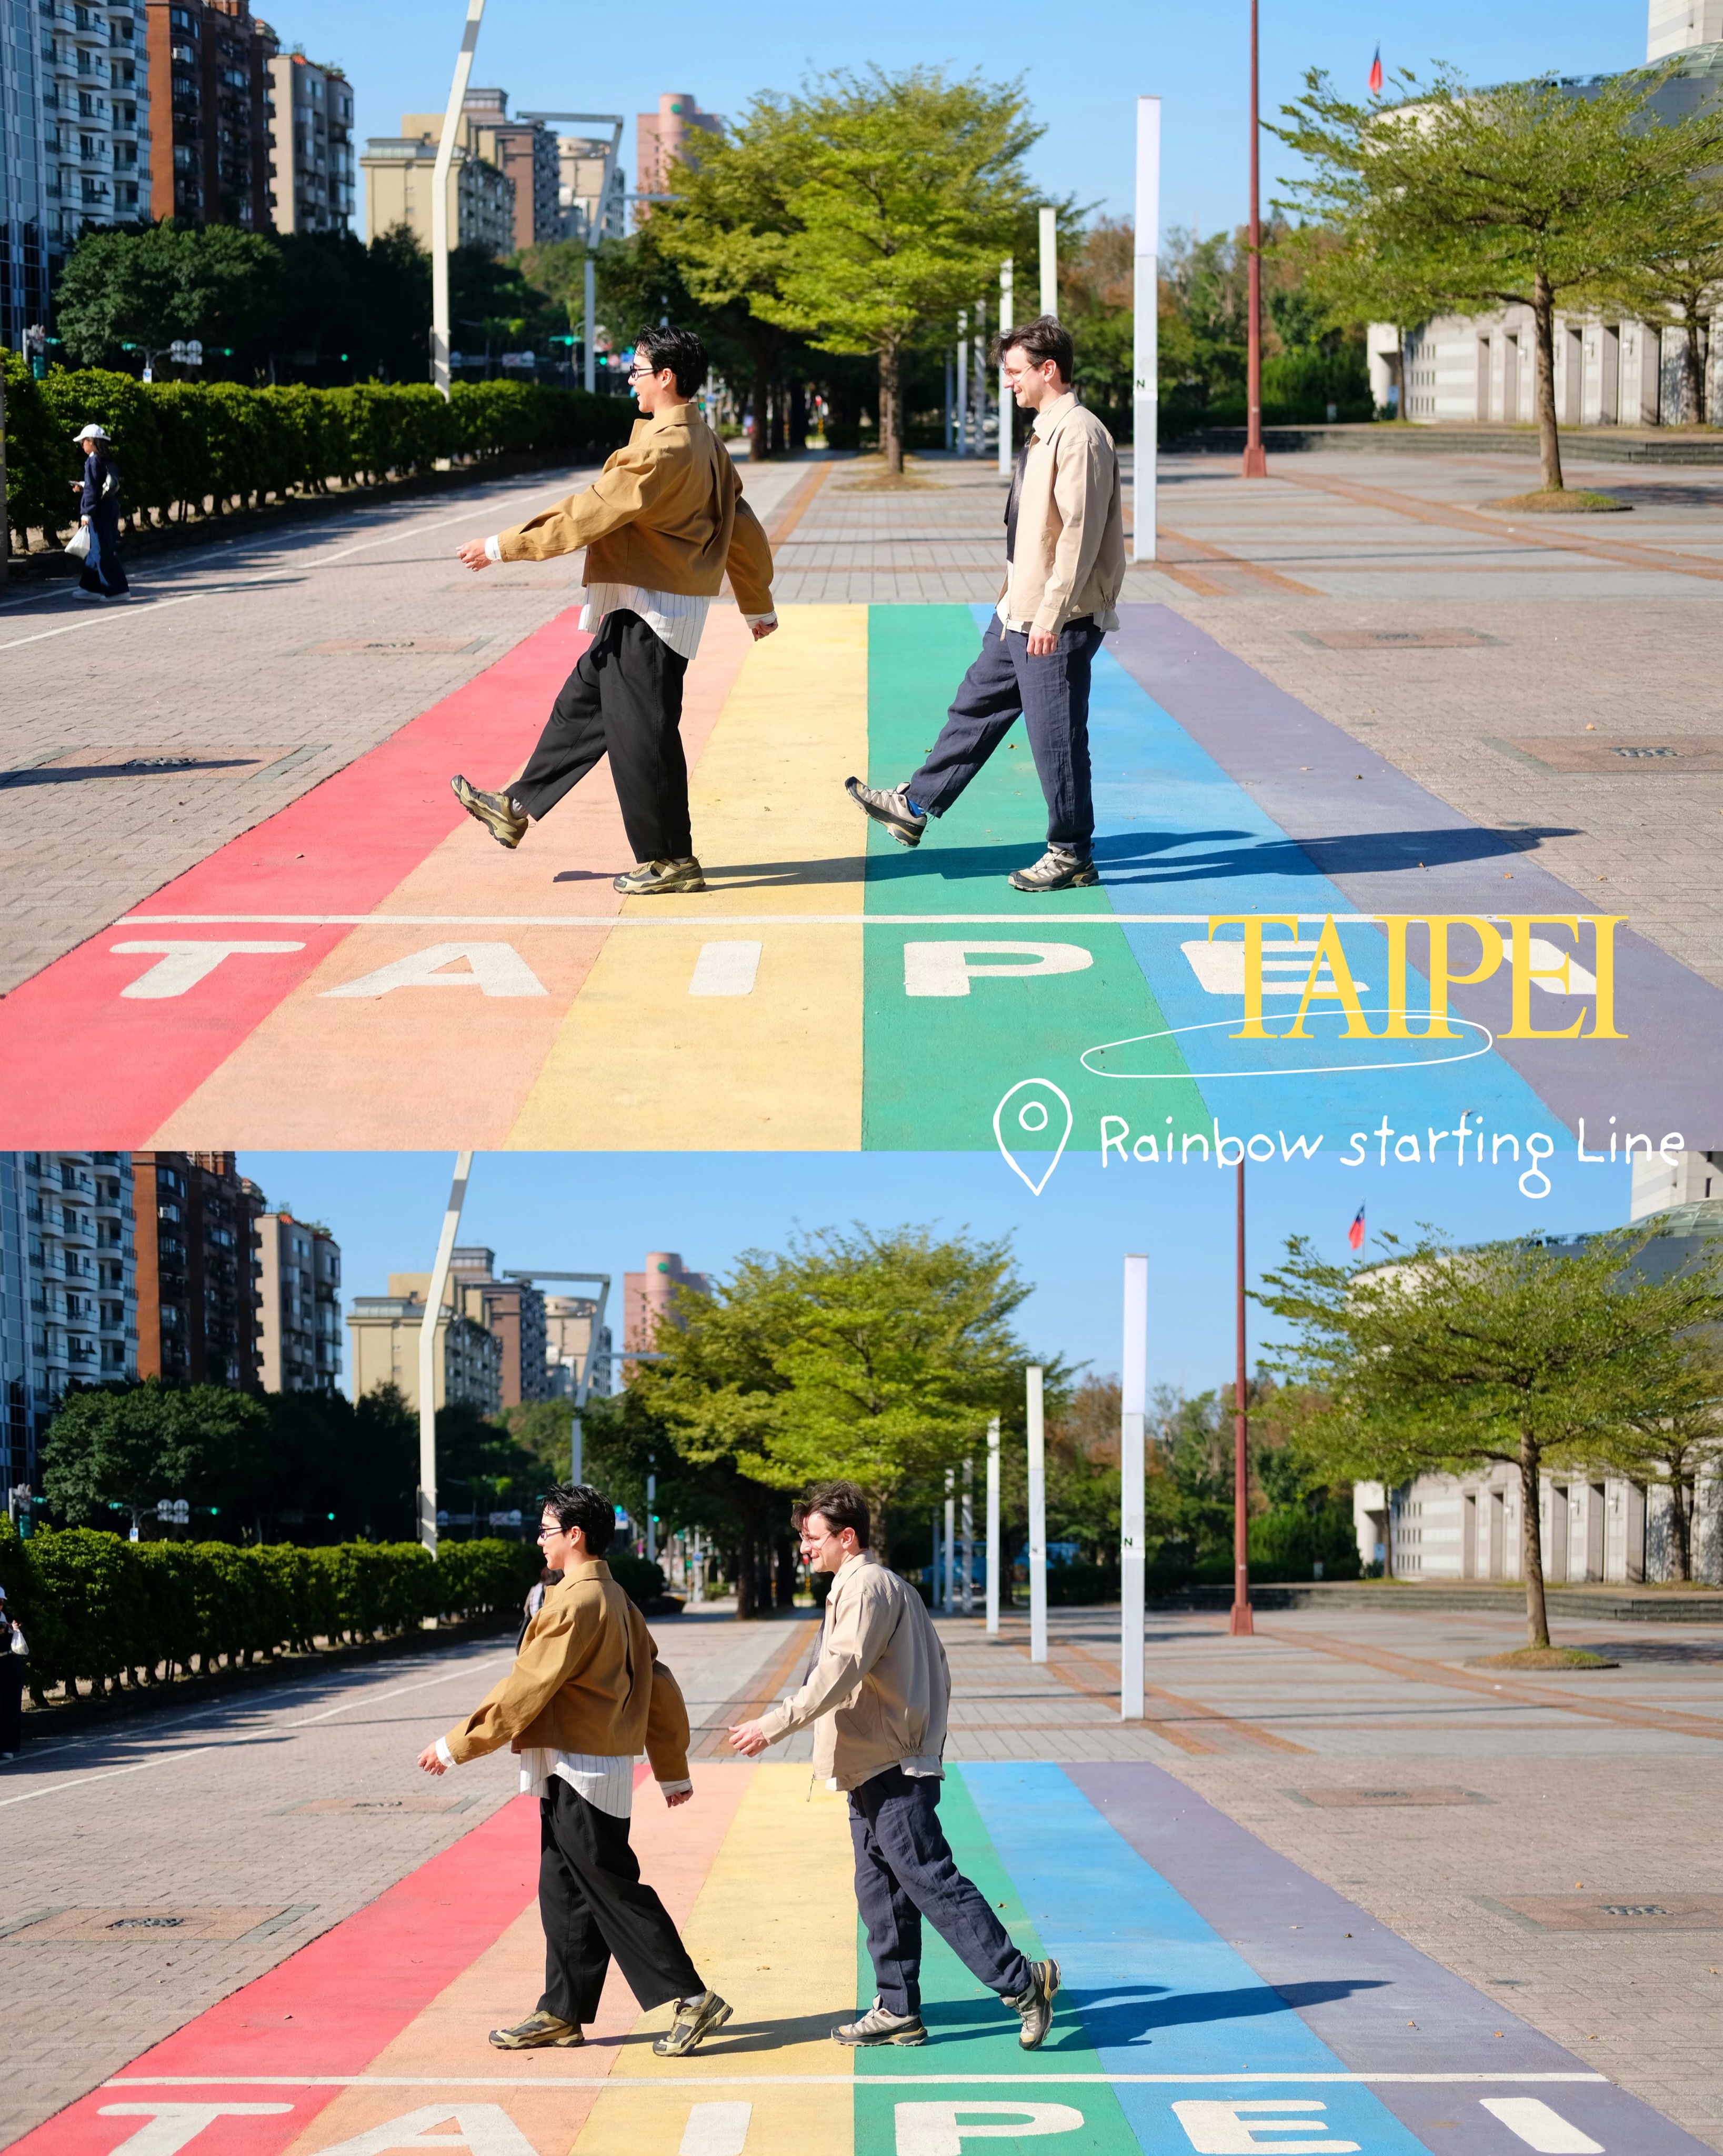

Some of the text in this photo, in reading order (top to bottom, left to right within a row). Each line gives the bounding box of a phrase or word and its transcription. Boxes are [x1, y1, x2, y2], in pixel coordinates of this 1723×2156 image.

[1137, 379, 1145, 388] N
[1124, 1538, 1133, 1546] N
[96, 2097, 1607, 2156] TAIPEI
